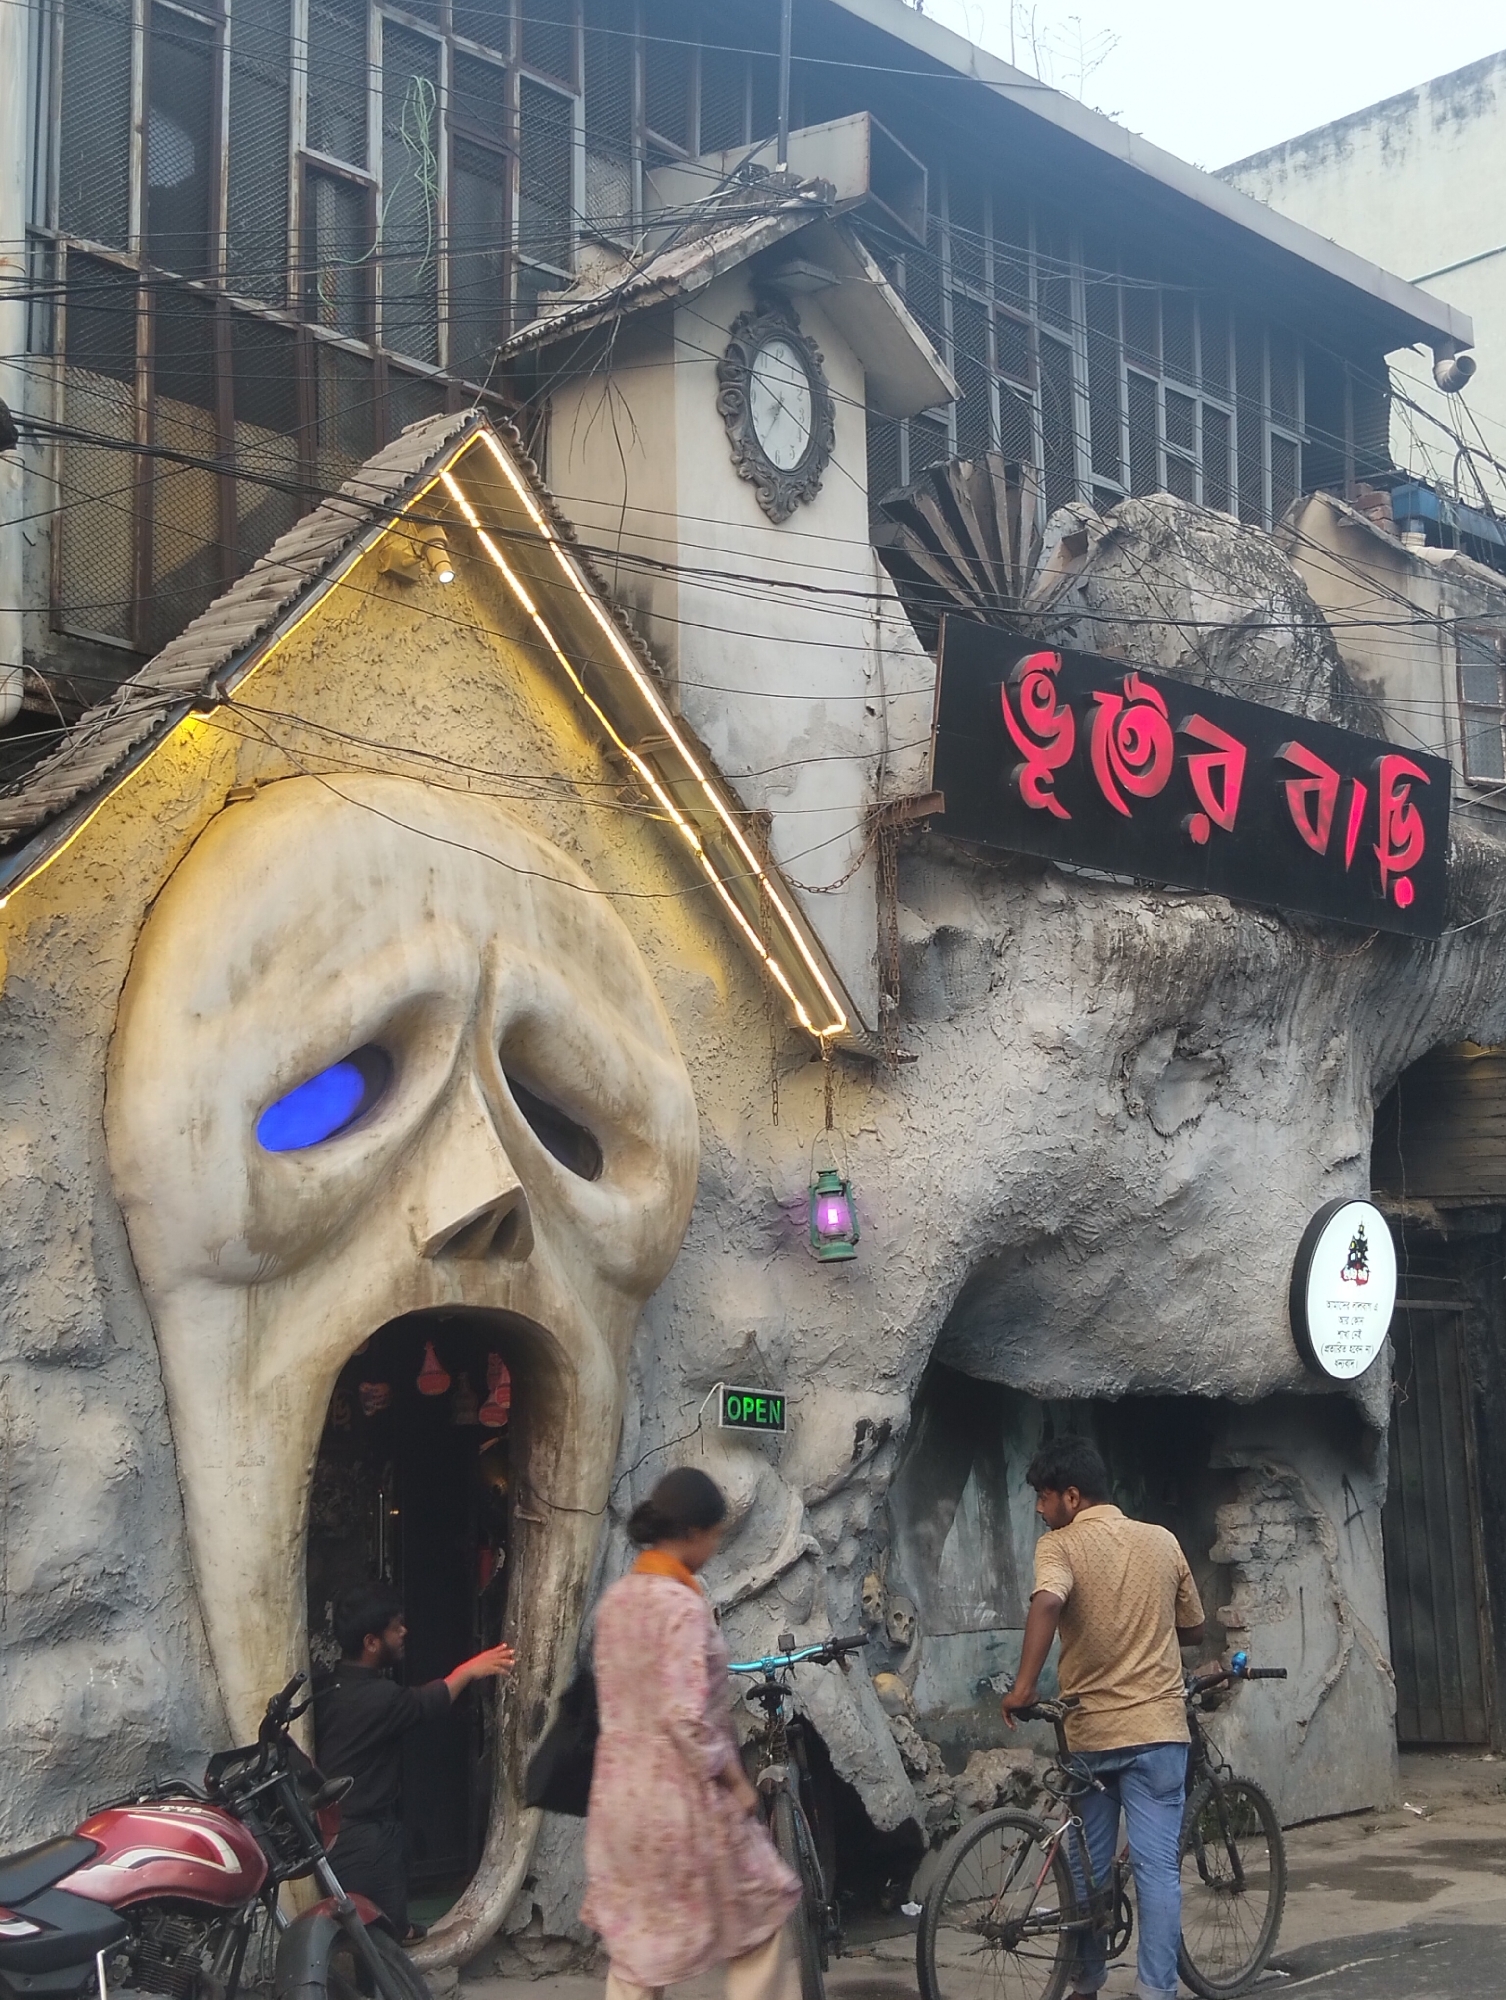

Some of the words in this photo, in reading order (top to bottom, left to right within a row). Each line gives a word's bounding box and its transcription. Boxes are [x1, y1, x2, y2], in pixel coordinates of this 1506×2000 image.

[796, 388, 803, 402] 2
[798, 408, 805, 424] 3
[774, 449, 781, 466] 6
[1001, 650, 1247, 845] ভূতের
[1279, 741, 1432, 909] বাড়ি
[727, 1395, 781, 1424] OPEN
[159, 1805, 203, 1815] TVS
